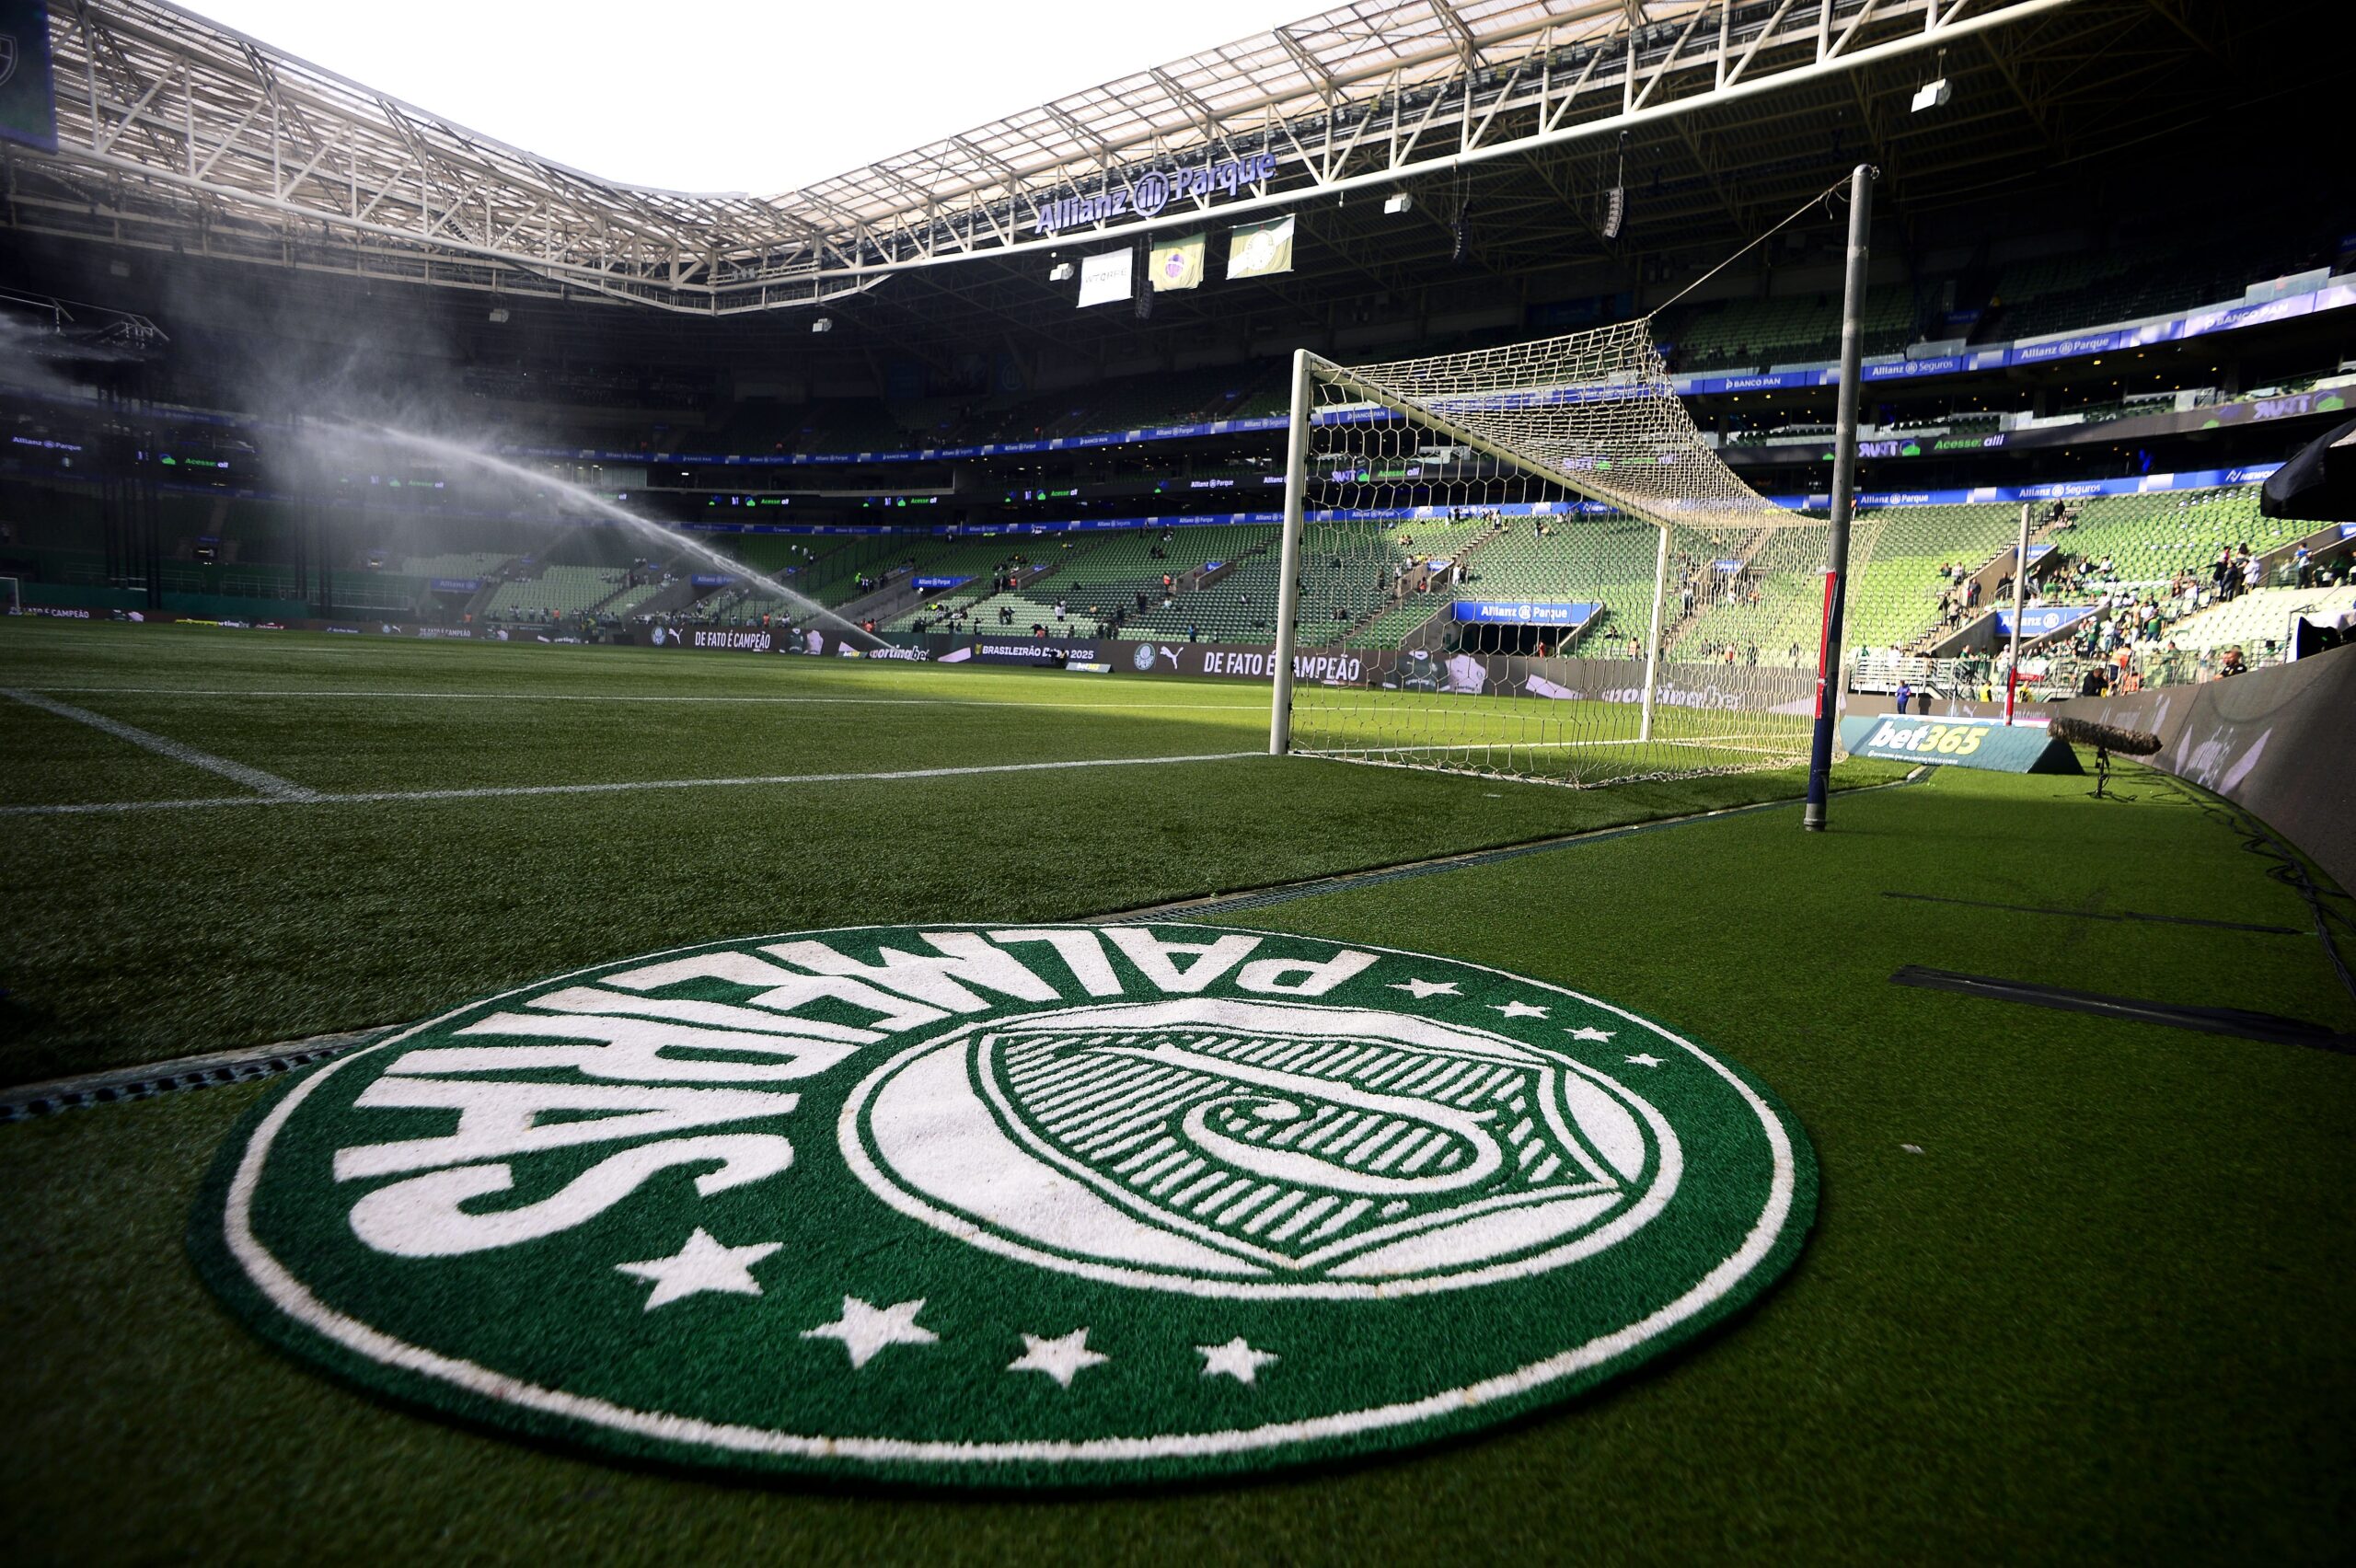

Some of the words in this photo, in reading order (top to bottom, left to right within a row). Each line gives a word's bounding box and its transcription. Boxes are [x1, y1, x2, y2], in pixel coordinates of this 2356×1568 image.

[1034, 190, 1128, 235] Allianz
[1176, 153, 1276, 200] Parque
[2215, 310, 2258, 327] BANCO
[2021, 344, 2057, 358] Allianz
[2073, 337, 2109, 351] Parque
[1872, 365, 1904, 377] Allianz
[1918, 360, 1953, 374] Seguros
[1734, 378, 1762, 387] BANCO
[1763, 376, 1781, 386] PAN
[1181, 428, 1195, 437] Parque
[13, 435, 42, 446] Allianz
[55, 442, 82, 452] Parque
[1190, 480, 1209, 490] Allianz
[1218, 478, 1234, 489] Parque
[1264, 476, 1284, 485] Allianz
[1860, 495, 1889, 505] Allianz
[1901, 493, 1929, 505] Parque
[2019, 488, 2051, 499] Allianz
[2064, 483, 2101, 497] Seguros
[1199, 516, 1214, 525] Parque
[918, 578, 933, 586] Allianz
[937, 578, 952, 588] Parque
[1481, 605, 1517, 617] Allianz
[1532, 607, 1568, 621] Parque
[695, 631, 706, 646] DE
[707, 632, 726, 647] FATO
[727, 630, 733, 647] É
[733, 630, 771, 651] CAMPEÃO
[982, 644, 1041, 658] BRASILEIRÃO
[1070, 650, 1095, 661] 2025
[1203, 651, 1223, 674] DE
[1225, 653, 1264, 676] FATO
[1292, 653, 1361, 682] AMPEÃO
[1868, 721, 1991, 756] bet365
[329, 926, 1380, 1260] PALMEIRAS
